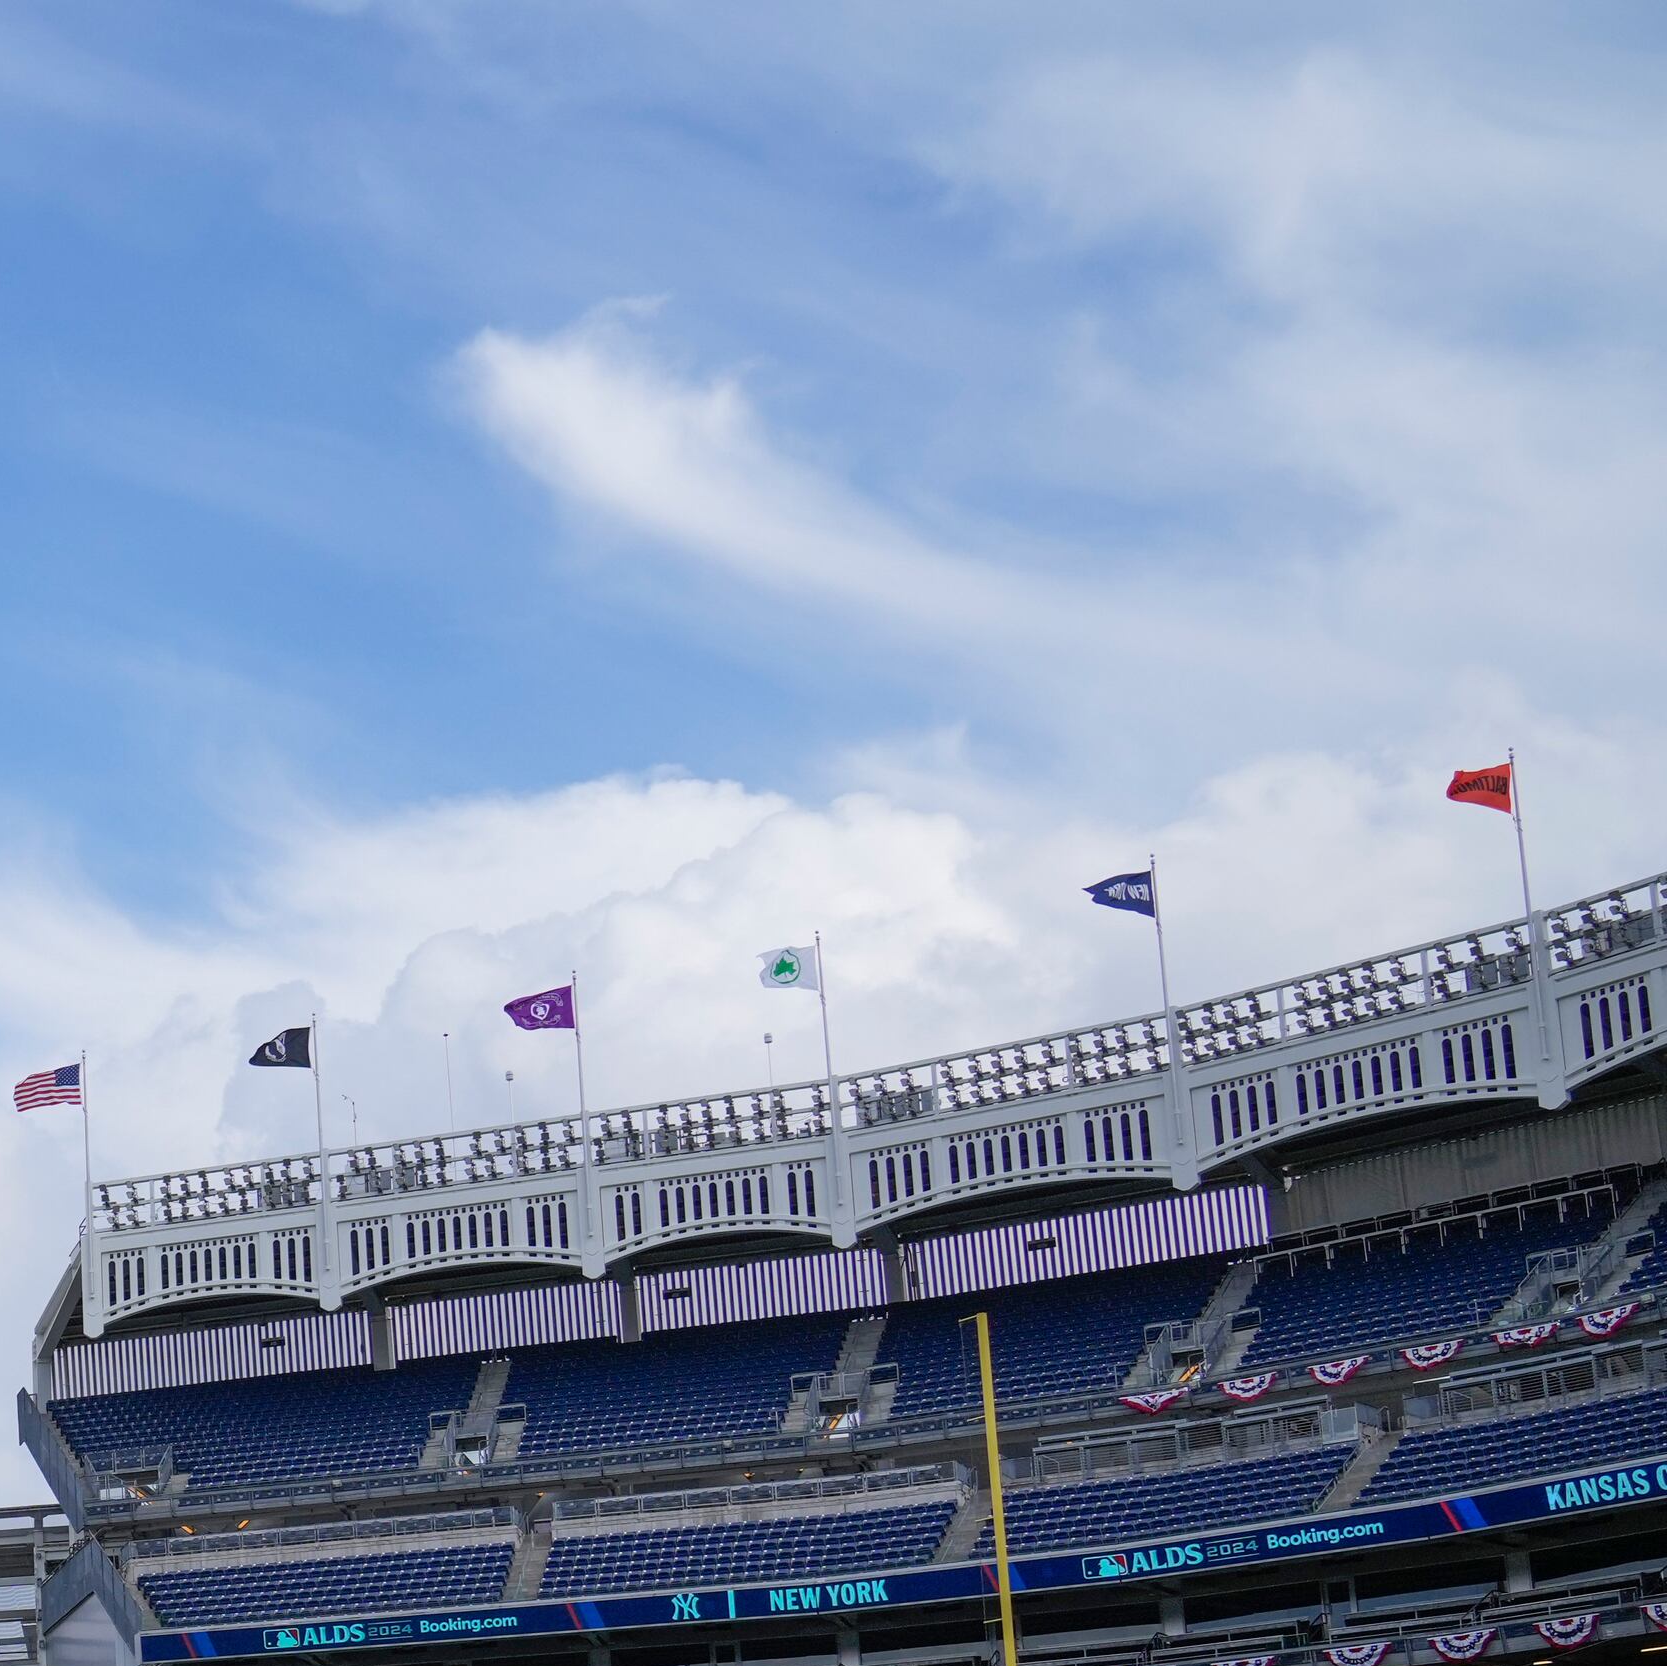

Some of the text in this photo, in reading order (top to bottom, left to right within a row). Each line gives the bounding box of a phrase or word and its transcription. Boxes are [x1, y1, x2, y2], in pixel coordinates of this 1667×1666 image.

[1131, 1543, 1204, 1573] ALDS
[1206, 1540, 1258, 1559] 2024
[1266, 1520, 1384, 1550] Booking.com
[1545, 1470, 1650, 1512] KANSAS
[770, 1587, 820, 1611] NEW
[826, 1579, 889, 1607] YORK
[303, 1616, 517, 1646] ALDS 2024 Booking.com
